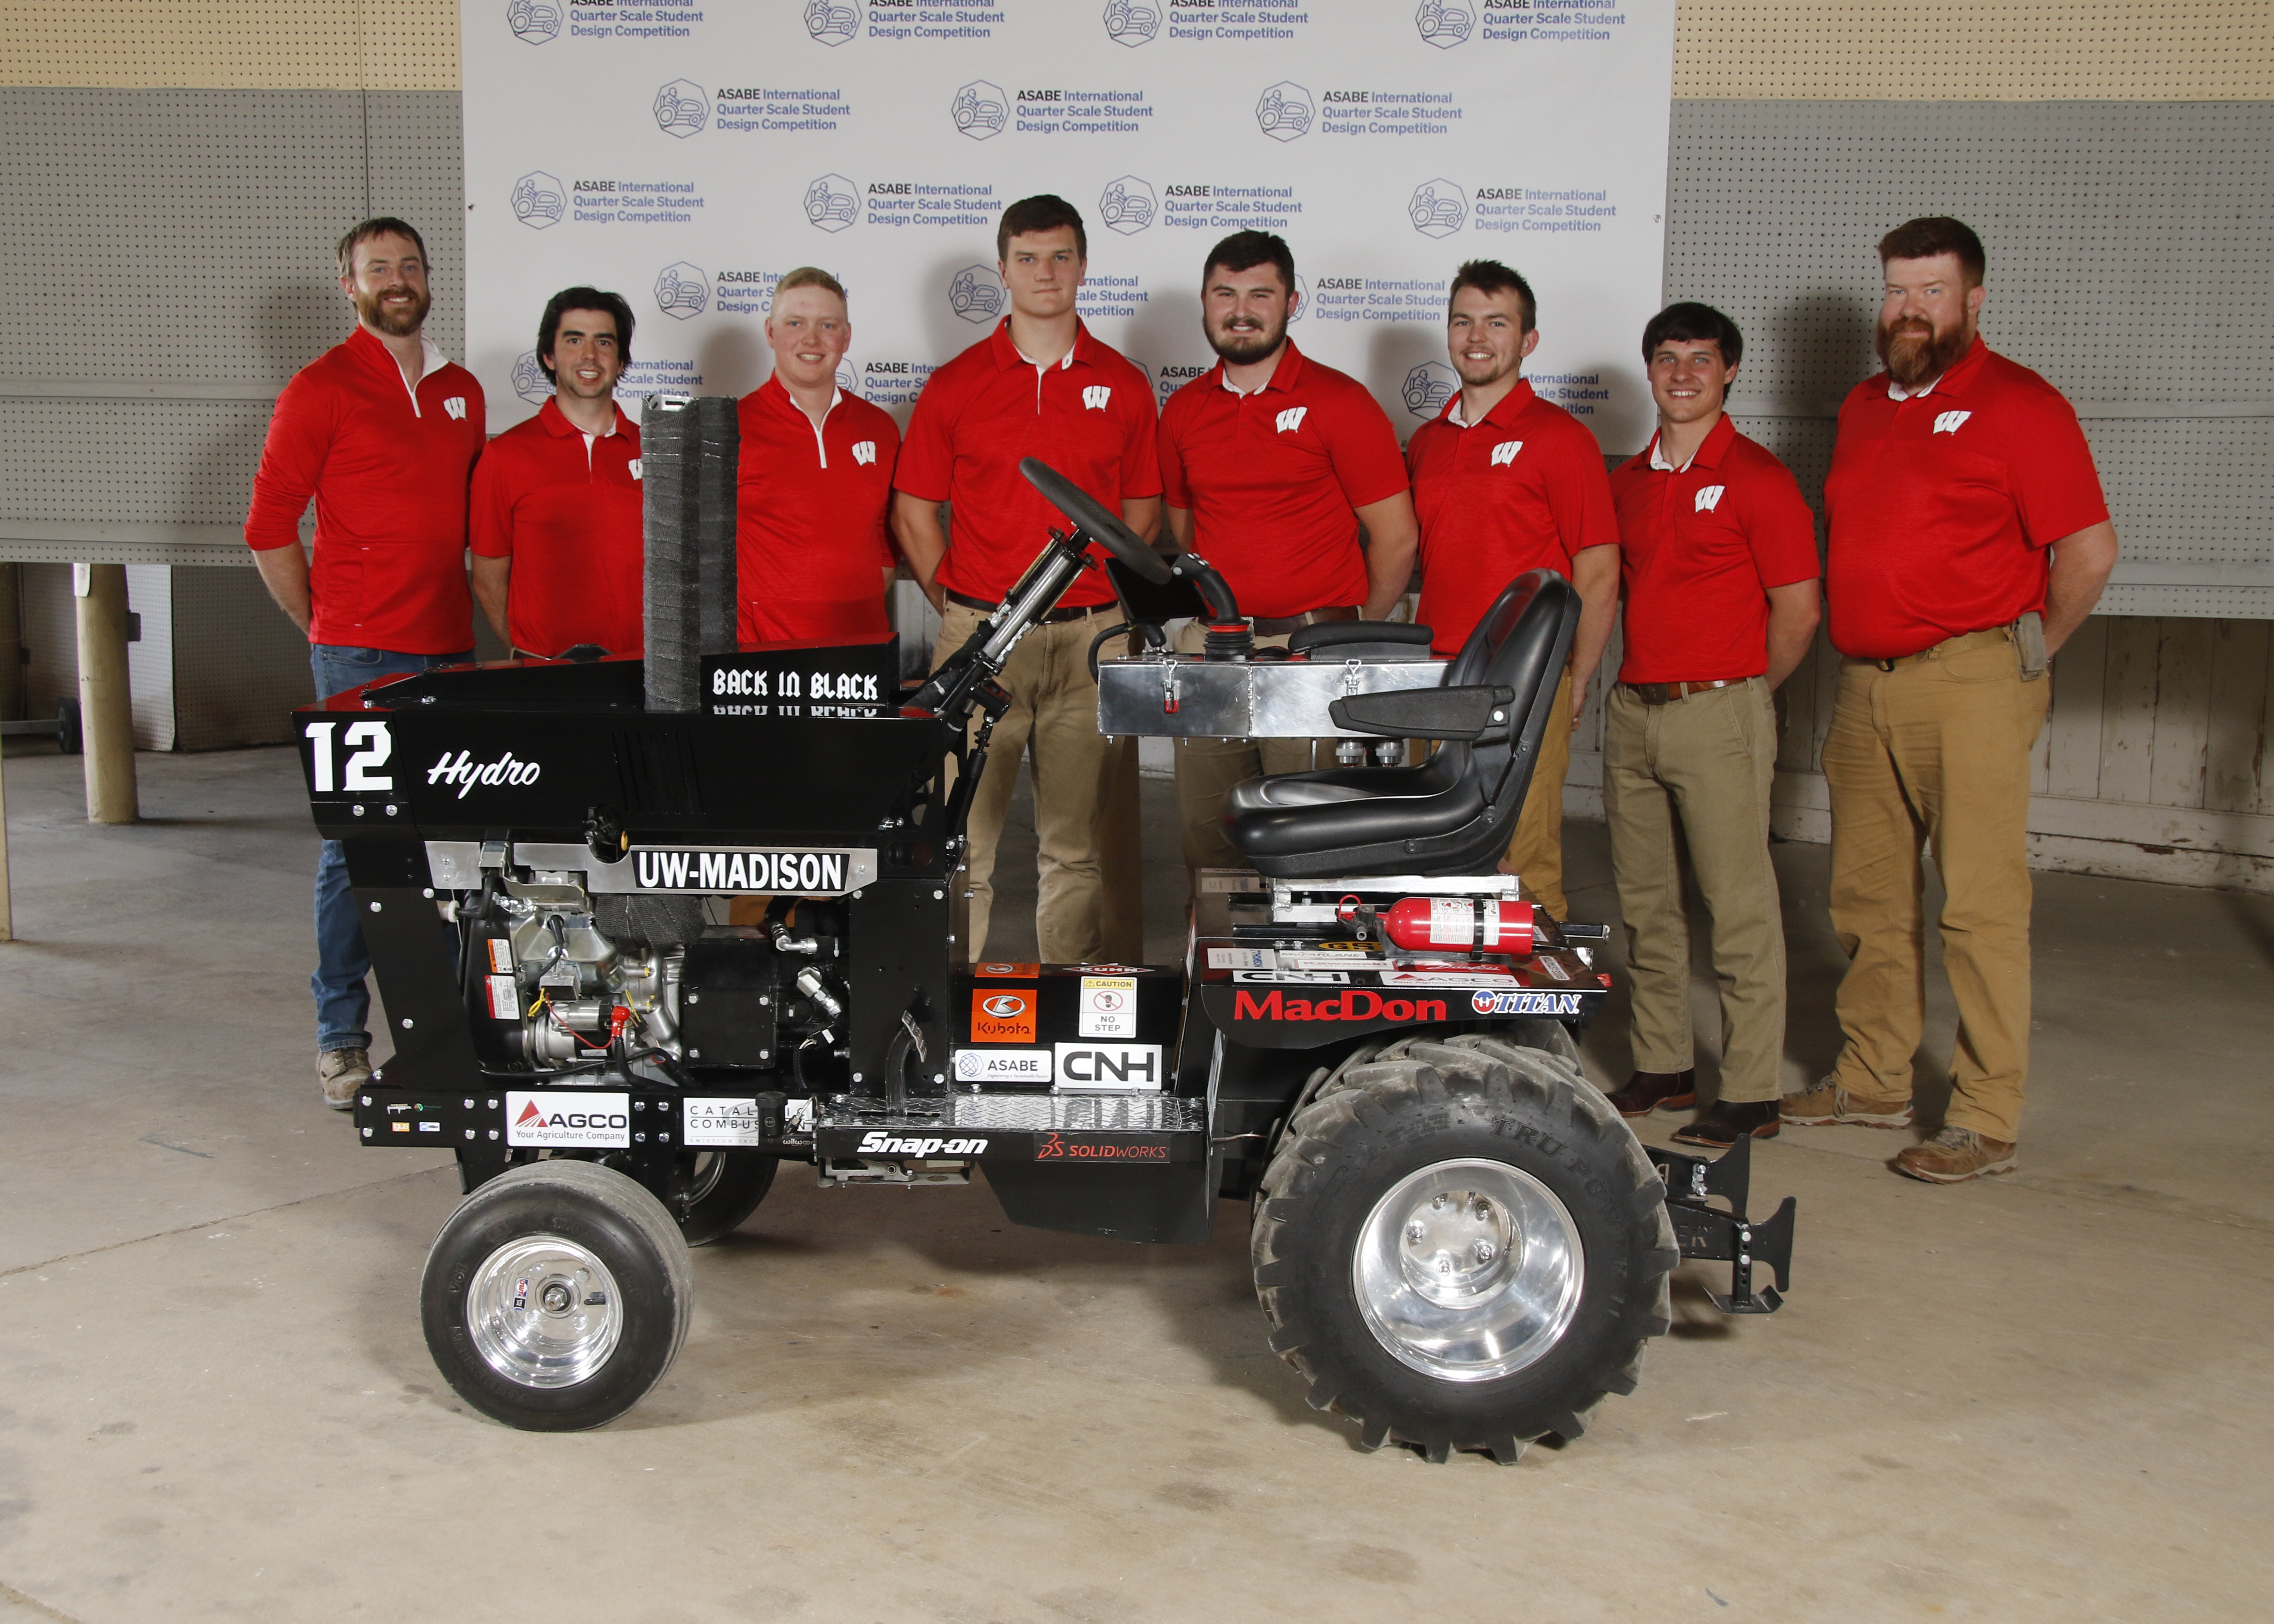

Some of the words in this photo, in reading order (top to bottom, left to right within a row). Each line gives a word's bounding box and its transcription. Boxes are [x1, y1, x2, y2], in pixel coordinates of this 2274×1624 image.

[1484, 0, 1530, 9] ASABE
[1533, 0, 1615, 9] International
[570, 9, 617, 22] Quarter
[619, 10, 653, 22] Scale
[656, 10, 703, 22] Student
[868, 10, 917, 23] Quarter
[919, 10, 953, 22] Scale
[955, 11, 1004, 23] Student
[1170, 11, 1219, 24] Quarter
[1221, 11, 1256, 23] Scale
[1258, 11, 1308, 23] Student
[1483, 12, 1534, 26] Quarter
[1536, 12, 1571, 24] Scale
[1574, 13, 1625, 24] Student
[571, 25, 612, 39] Design
[615, 25, 689, 39] Competition
[869, 26, 911, 39] Design
[914, 25, 990, 39] Competition
[1169, 26, 1212, 40] Design
[1216, 26, 1293, 40] Competition
[1483, 28, 1527, 42] Design
[1530, 28, 1610, 42] Competition
[717, 88, 761, 100] ASABE
[763, 89, 840, 100] International
[1016, 90, 1062, 102] ASABE
[1064, 90, 1143, 102] International
[1323, 91, 1369, 103] ASABE
[1372, 92, 1452, 103] International
[717, 103, 765, 116] Quarter
[766, 103, 800, 115] Scale
[802, 103, 850, 115] Student
[1016, 105, 1065, 117] Quarter
[1067, 105, 1102, 117] Scale
[1103, 105, 1153, 117] Student
[1322, 106, 1372, 119] Quarter
[1375, 107, 1409, 118] Scale
[1412, 107, 1462, 118] Student
[717, 118, 759, 132] Design
[761, 118, 836, 132] Competition
[1016, 120, 1059, 134] Design
[1062, 120, 1139, 134] Competition
[1322, 122, 1366, 136] Design
[1369, 122, 1447, 136] Competition
[573, 180, 616, 192] ASABE
[618, 181, 694, 193] International
[868, 183, 912, 195] ASABE
[914, 183, 992, 195] International
[1165, 185, 1210, 197] ASABE
[1213, 186, 1292, 197] International
[573, 195, 619, 207] Quarter
[622, 196, 654, 207] Scale
[657, 196, 704, 207] Student
[1476, 188, 1522, 200] ASABE
[1525, 189, 1606, 201] International
[868, 198, 915, 211] Quarter
[918, 198, 952, 210] Scale
[953, 199, 1002, 210] Student
[1164, 200, 1214, 213] Quarter
[1216, 200, 1250, 212] Scale
[1252, 201, 1302, 212] Student
[1476, 203, 1525, 216] Quarter
[1528, 204, 1563, 215] Scale
[1565, 204, 1616, 216] Student
[574, 210, 615, 224] Design
[617, 211, 691, 224] Competition
[868, 213, 909, 227] Design
[912, 213, 987, 227] Competition
[1164, 215, 1207, 229] Design
[1211, 215, 1287, 230] Competition
[1476, 219, 1519, 232] Design
[1522, 219, 1601, 233] Competition
[717, 272, 760, 282] ASABE
[1085, 275, 1138, 286] rnational
[1317, 278, 1362, 289] ASABE
[1365, 279, 1445, 290] International
[717, 286, 764, 298] Quarter
[1075, 290, 1097, 301] cale
[1100, 290, 1148, 301] Student
[1317, 293, 1365, 305] Quarter
[1368, 293, 1402, 305] Scale
[1405, 294, 1450, 306] Studen
[717, 301, 758, 313] Design
[1076, 305, 1134, 318] mpetition
[1316, 307, 1360, 321] Design
[1363, 308, 1440, 322] Competition
[630, 360, 693, 370] ternational
[865, 362, 908, 373] ASABE
[656, 374, 703, 385] Student
[865, 376, 912, 389] Quarter
[1519, 372, 1599, 384] Iternational
[865, 391, 906, 404] Design
[1537, 388, 1555, 398] ale
[1558, 388, 1609, 399] Student
[712, 669, 768, 696] BACK
[778, 671, 801, 698] IN
[809, 672, 878, 701] BLACK
[305, 721, 393, 791] 12
[427, 750, 540, 799] Hydro
[639, 851, 841, 890] UW-MADISON
[1234, 990, 1446, 1021] MacDon
[1494, 992, 1583, 1015] TITAN
[977, 1022, 1030, 1034] Kubota
[987, 1060, 1038, 1072] ASABE
[1063, 1051, 1155, 1082] CNH
[549, 1114, 627, 1129] AGCO
[537, 1131, 584, 1140] Agriculture
[586, 1132, 625, 1141] Company
[857, 1131, 988, 1157] Snap-on
[1069, 1145, 1166, 1158] SOLIDWORKS
